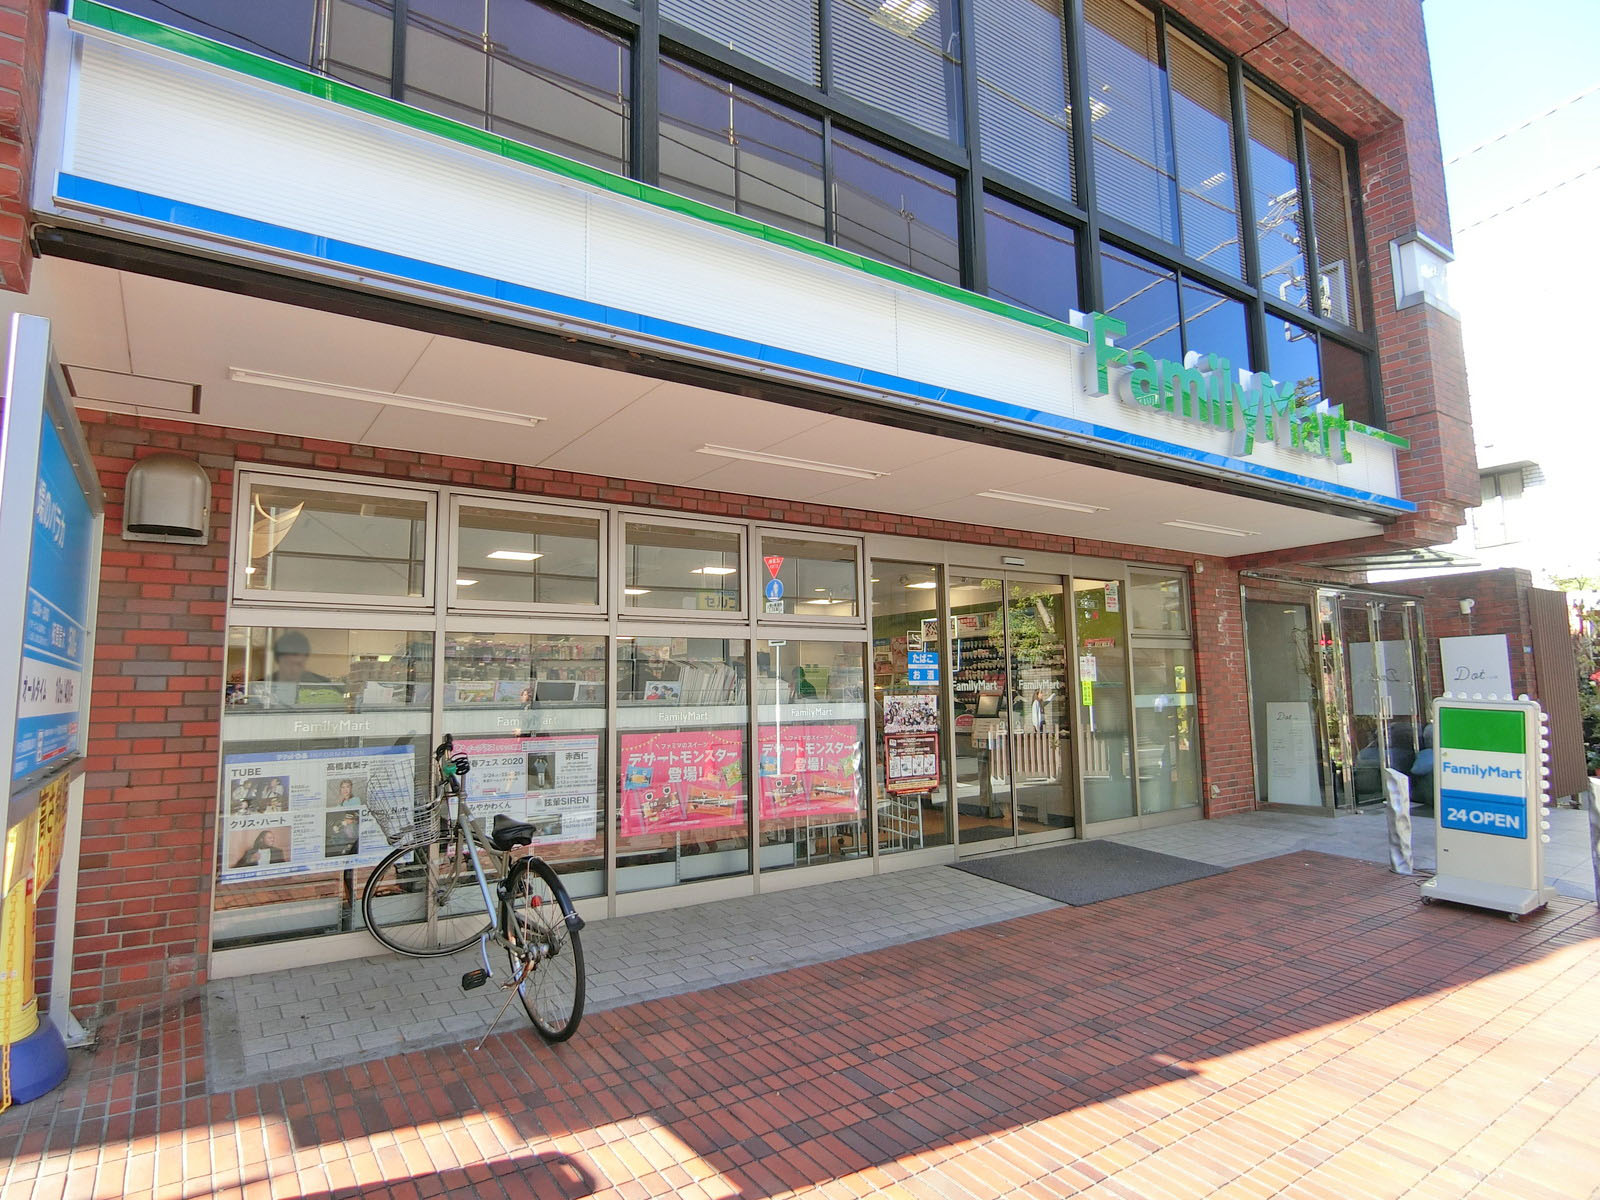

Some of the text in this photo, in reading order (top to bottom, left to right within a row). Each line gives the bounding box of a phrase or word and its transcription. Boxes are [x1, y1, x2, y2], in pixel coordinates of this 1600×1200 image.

[1081, 308, 1352, 466] FamilyMart
[912, 653, 934, 664] たばこ
[1453, 665, 1486, 681] Dot
[952, 679, 999, 694] FamilyMart
[1018, 679, 1060, 691] FamilyMart
[658, 712, 708, 722] FamilyMart
[791, 707, 833, 718] FamilyMart
[294, 719, 371, 733] FamilyMart
[502, 757, 524, 766] 2020
[565, 752, 589, 760] 赤西仁
[231, 768, 262, 777] TUBE
[1443, 761, 1523, 780] FamilyMart
